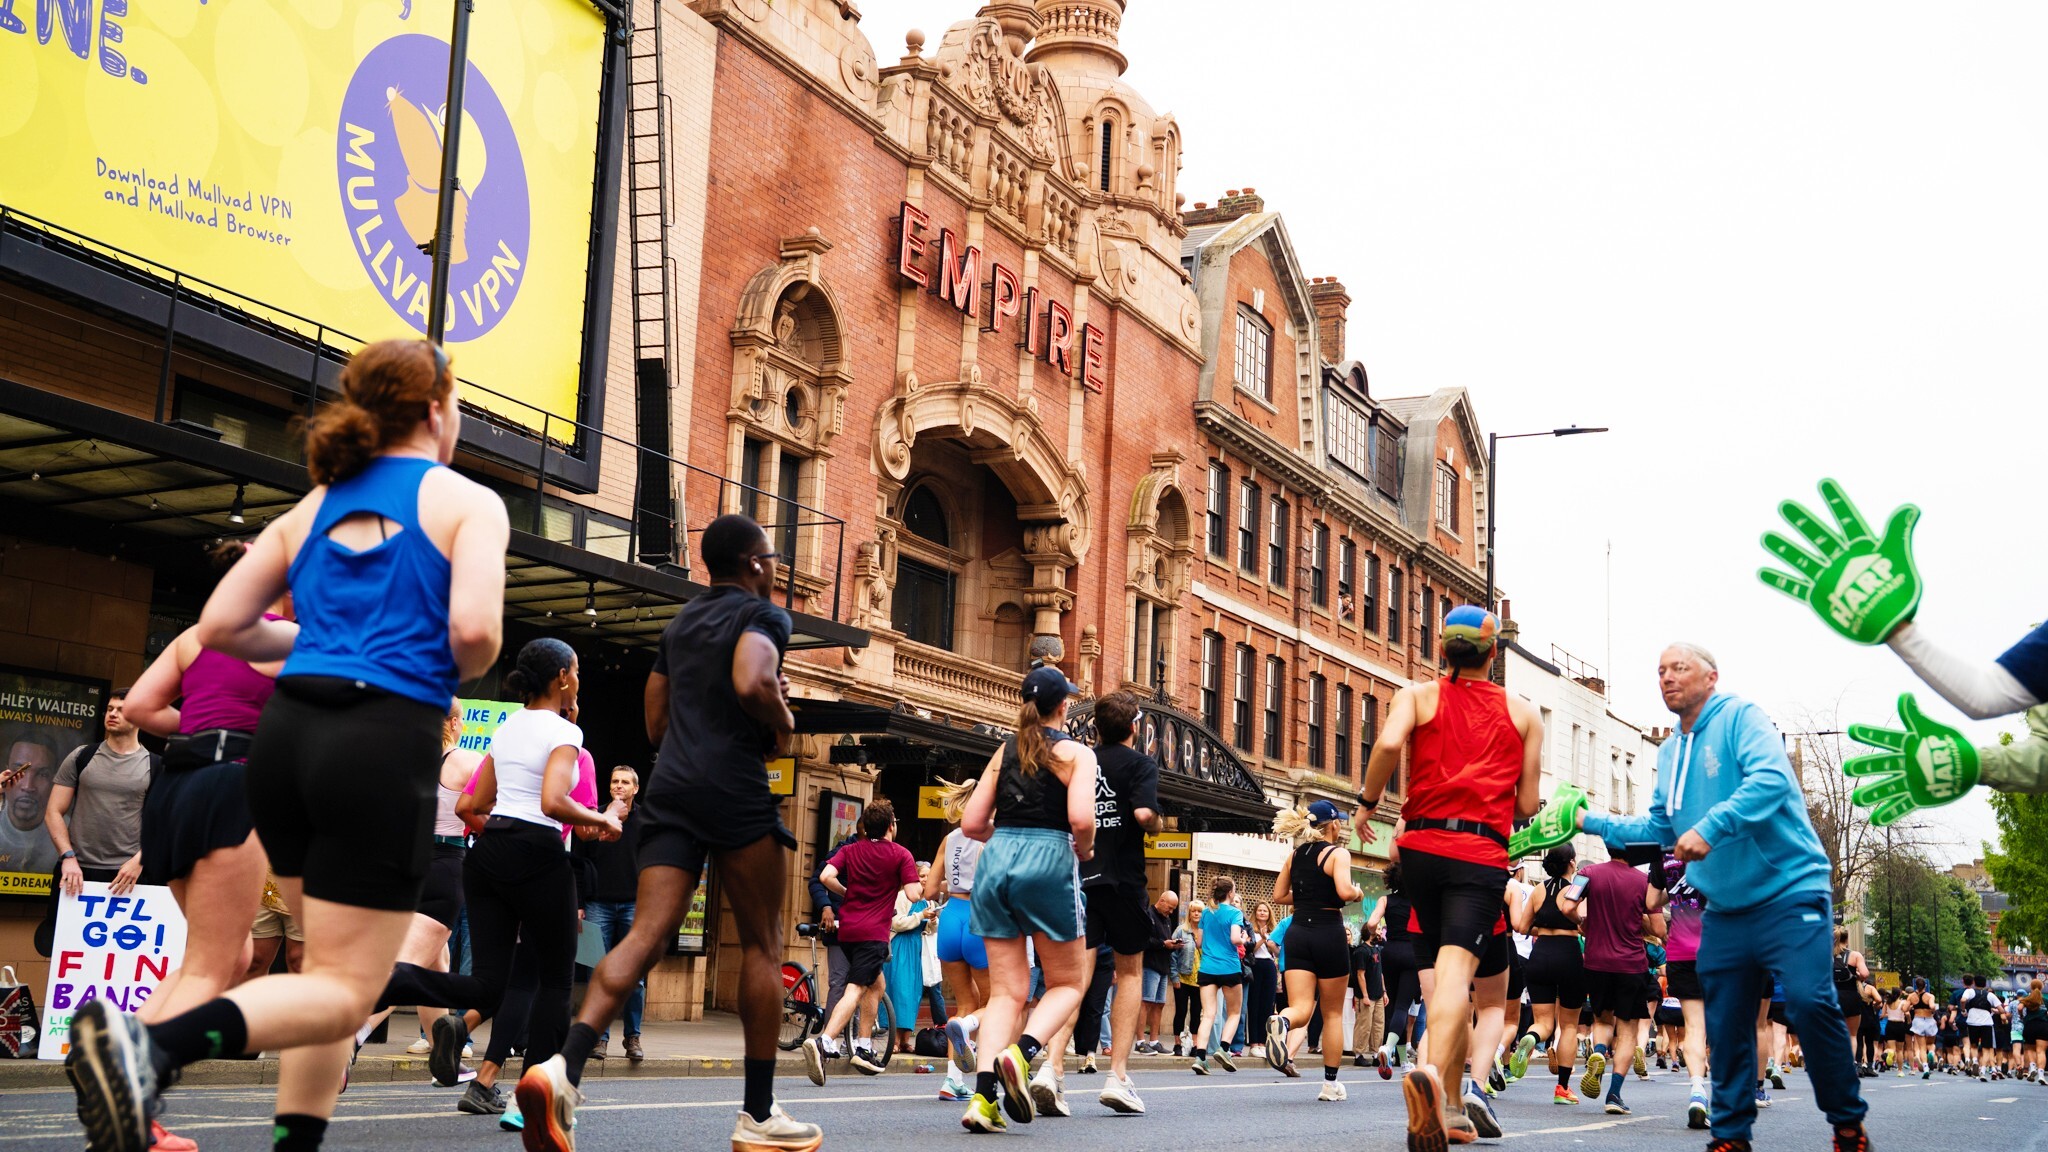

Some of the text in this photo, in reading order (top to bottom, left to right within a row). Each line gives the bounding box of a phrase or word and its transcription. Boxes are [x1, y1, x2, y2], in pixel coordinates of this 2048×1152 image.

[97, 157, 292, 219] Download Mullvad VPN
[104, 186, 291, 246] and Mullvad Browser
[460, 239, 521, 327] VPN
[897, 201, 1105, 394] EMPIRE
[1827, 557, 1894, 629] HARP
[0, 692, 96, 718] HLEY WALTERS
[35, 714, 83, 729] WINNING
[462, 708, 490, 723] IKE
[1925, 735, 1953, 798] HARP
[12, 877, 51, 888] DREAM
[952, 846, 963, 886] INOXTO
[78, 895, 152, 921] TFL
[82, 921, 165, 955] GO!
